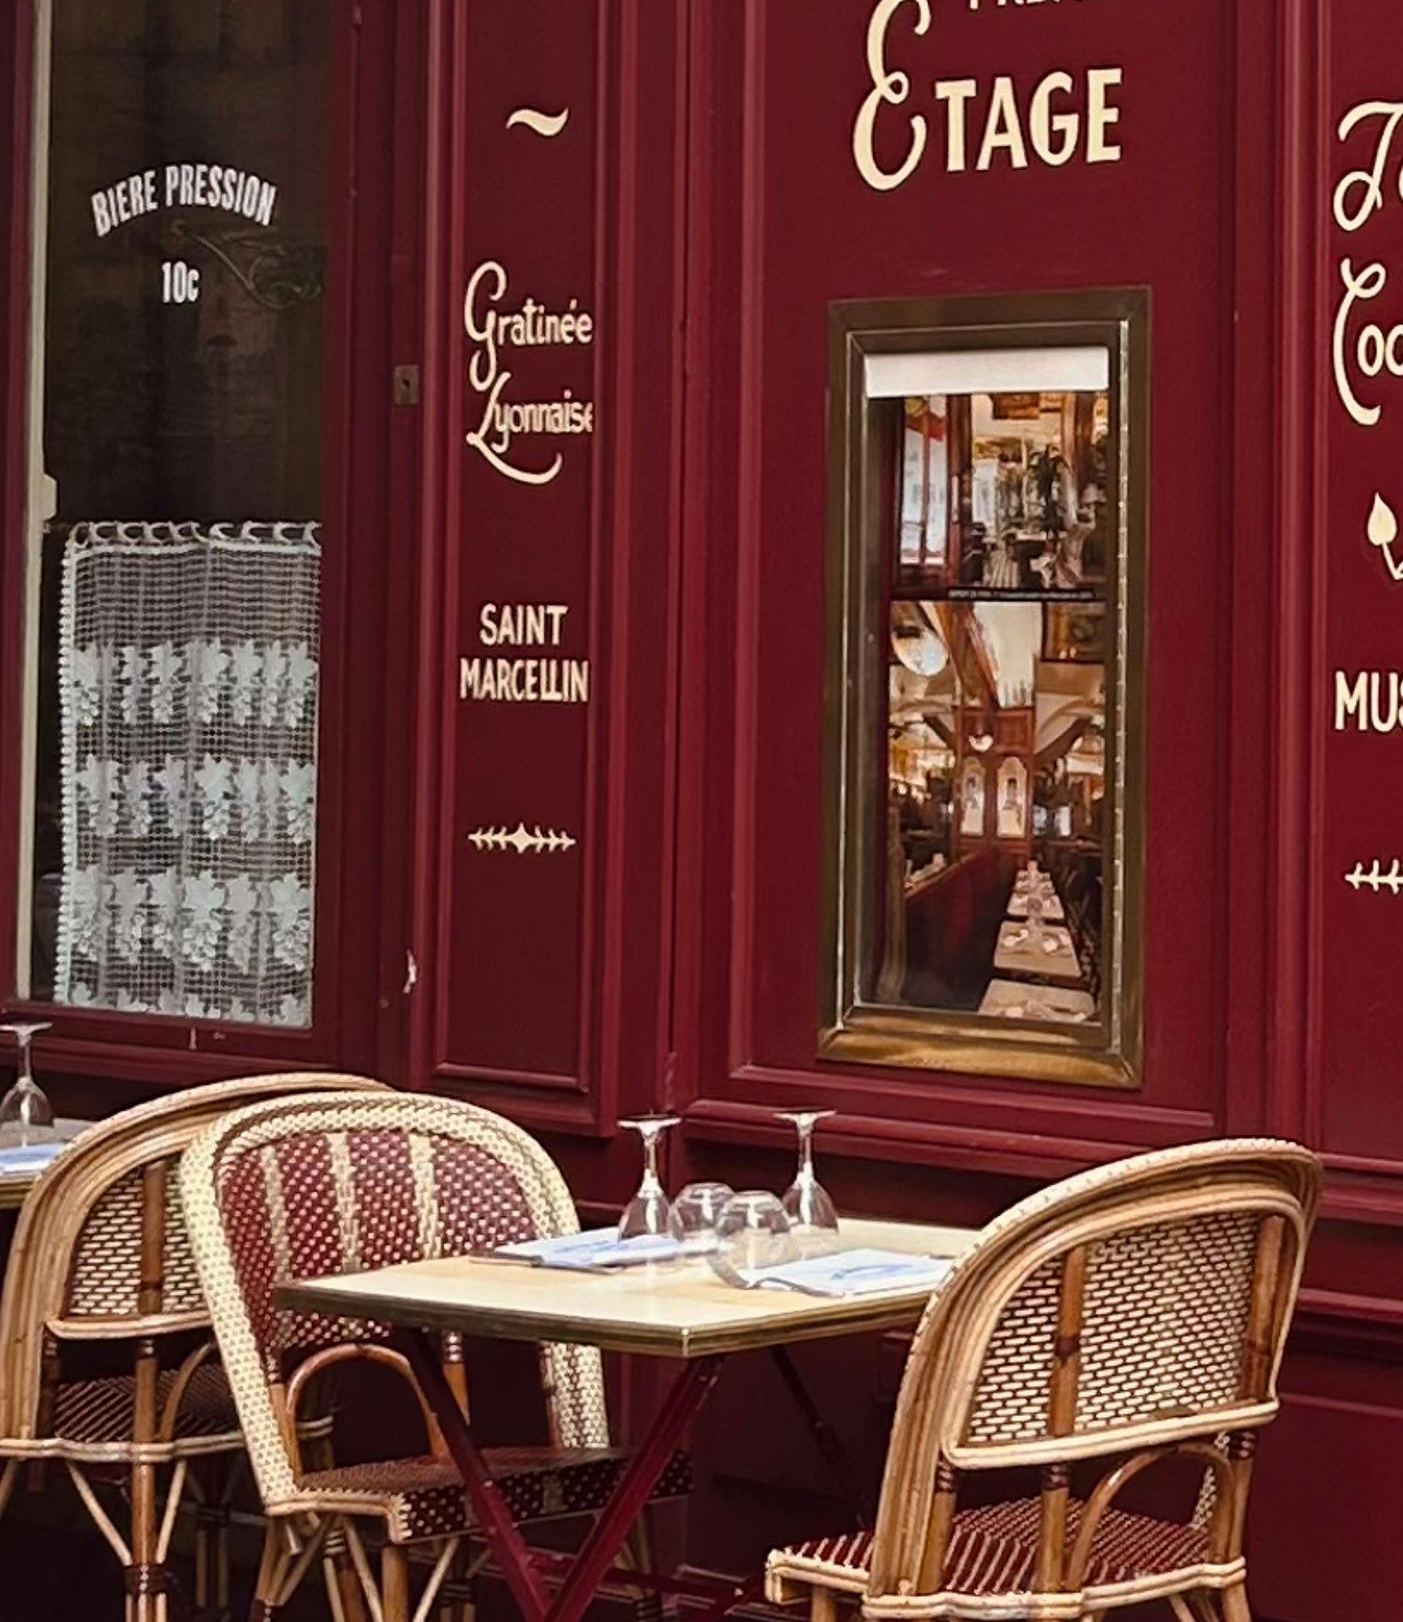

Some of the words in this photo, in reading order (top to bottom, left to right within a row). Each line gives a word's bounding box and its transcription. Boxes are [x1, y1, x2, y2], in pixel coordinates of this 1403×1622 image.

[91, 170, 158, 238] BIERE
[165, 163, 277, 227] PRESSION
[464, 261, 593, 392] Gratinée
[480, 603, 568, 646] SAINT
[459, 657, 589, 704] MARCELLIN
